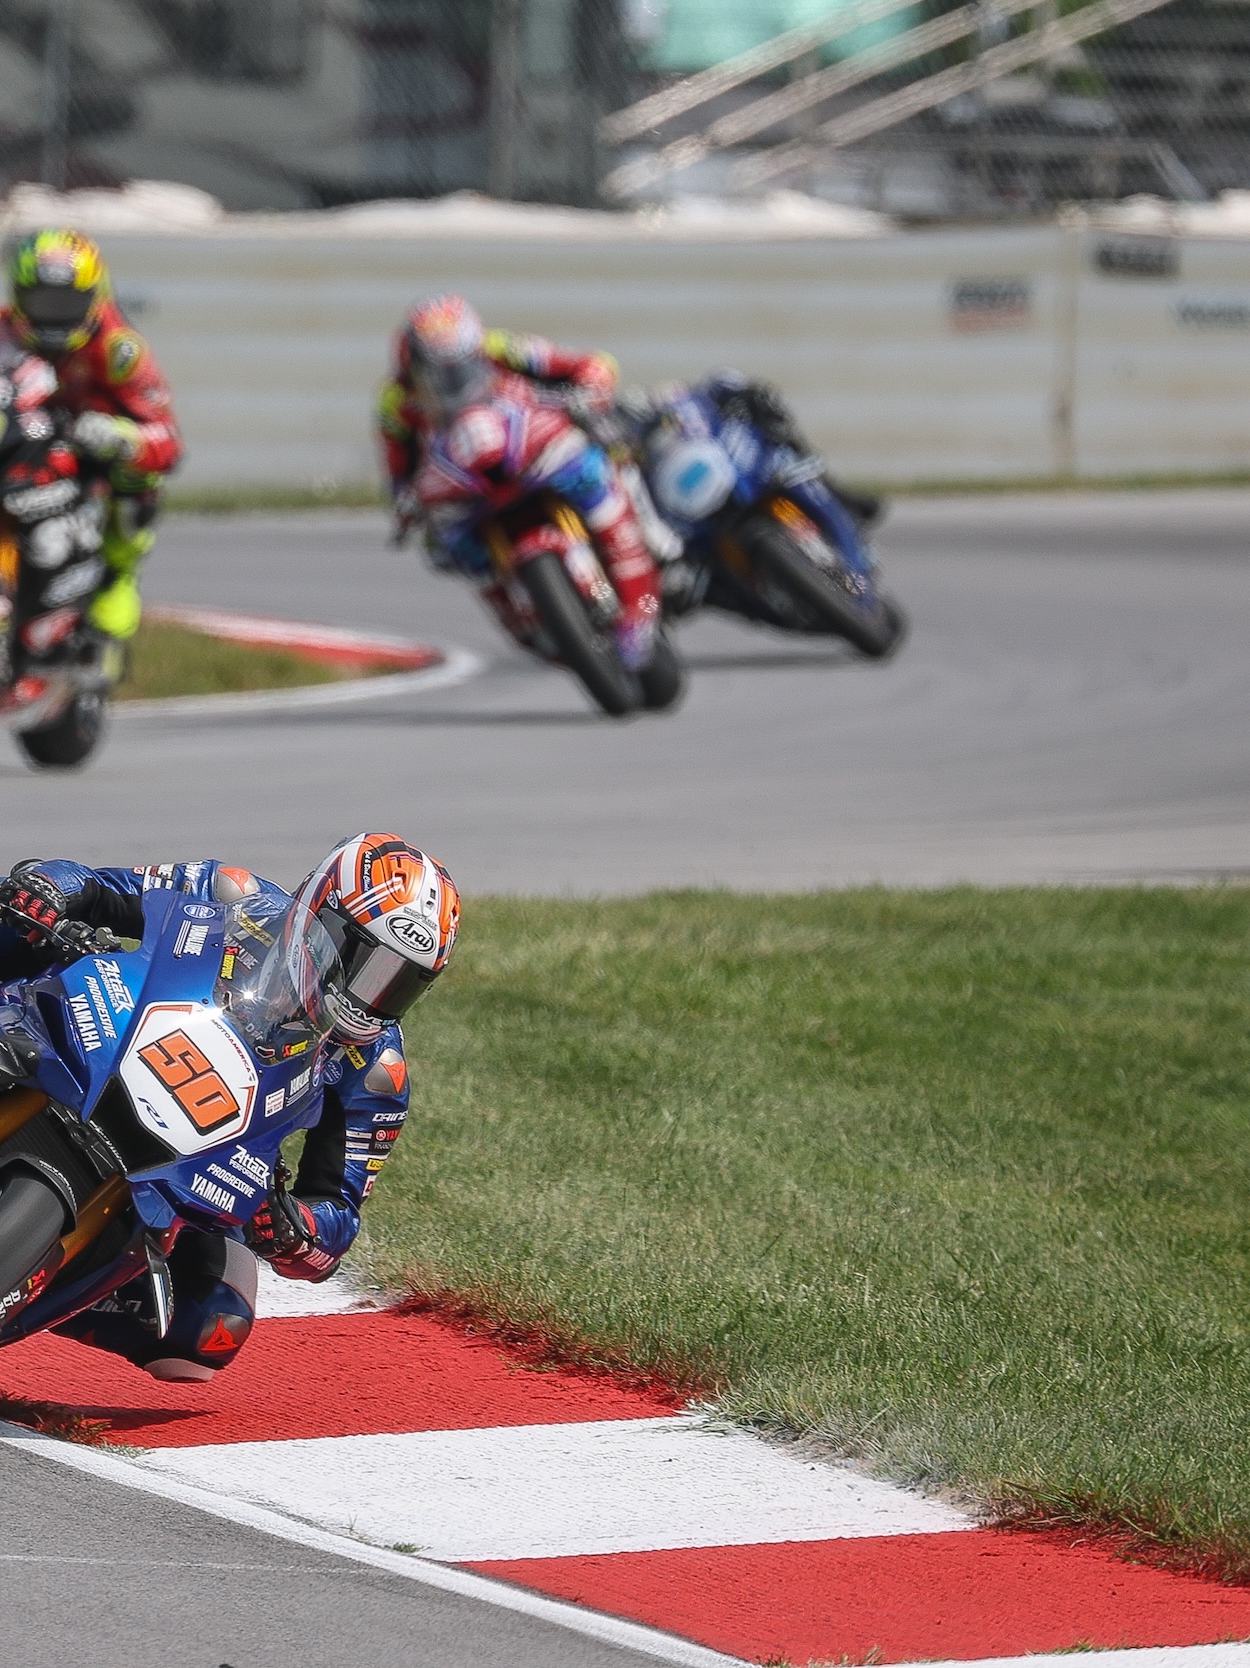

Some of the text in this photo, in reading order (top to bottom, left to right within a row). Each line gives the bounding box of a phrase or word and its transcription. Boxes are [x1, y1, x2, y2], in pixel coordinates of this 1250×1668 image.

[392, 923, 432, 948] Arai
[83, 974, 117, 1039] PROGRESSIVE
[100, 959, 136, 1015] Attack
[69, 993, 102, 1052] YAMAHA
[211, 1018, 252, 1073] MOTOAMERICA
[136, 1027, 241, 1137] 50
[191, 1173, 236, 1213] YAMAHA
[206, 1163, 256, 1198] PROGRESSIVE
[230, 1144, 270, 1190] Attack
